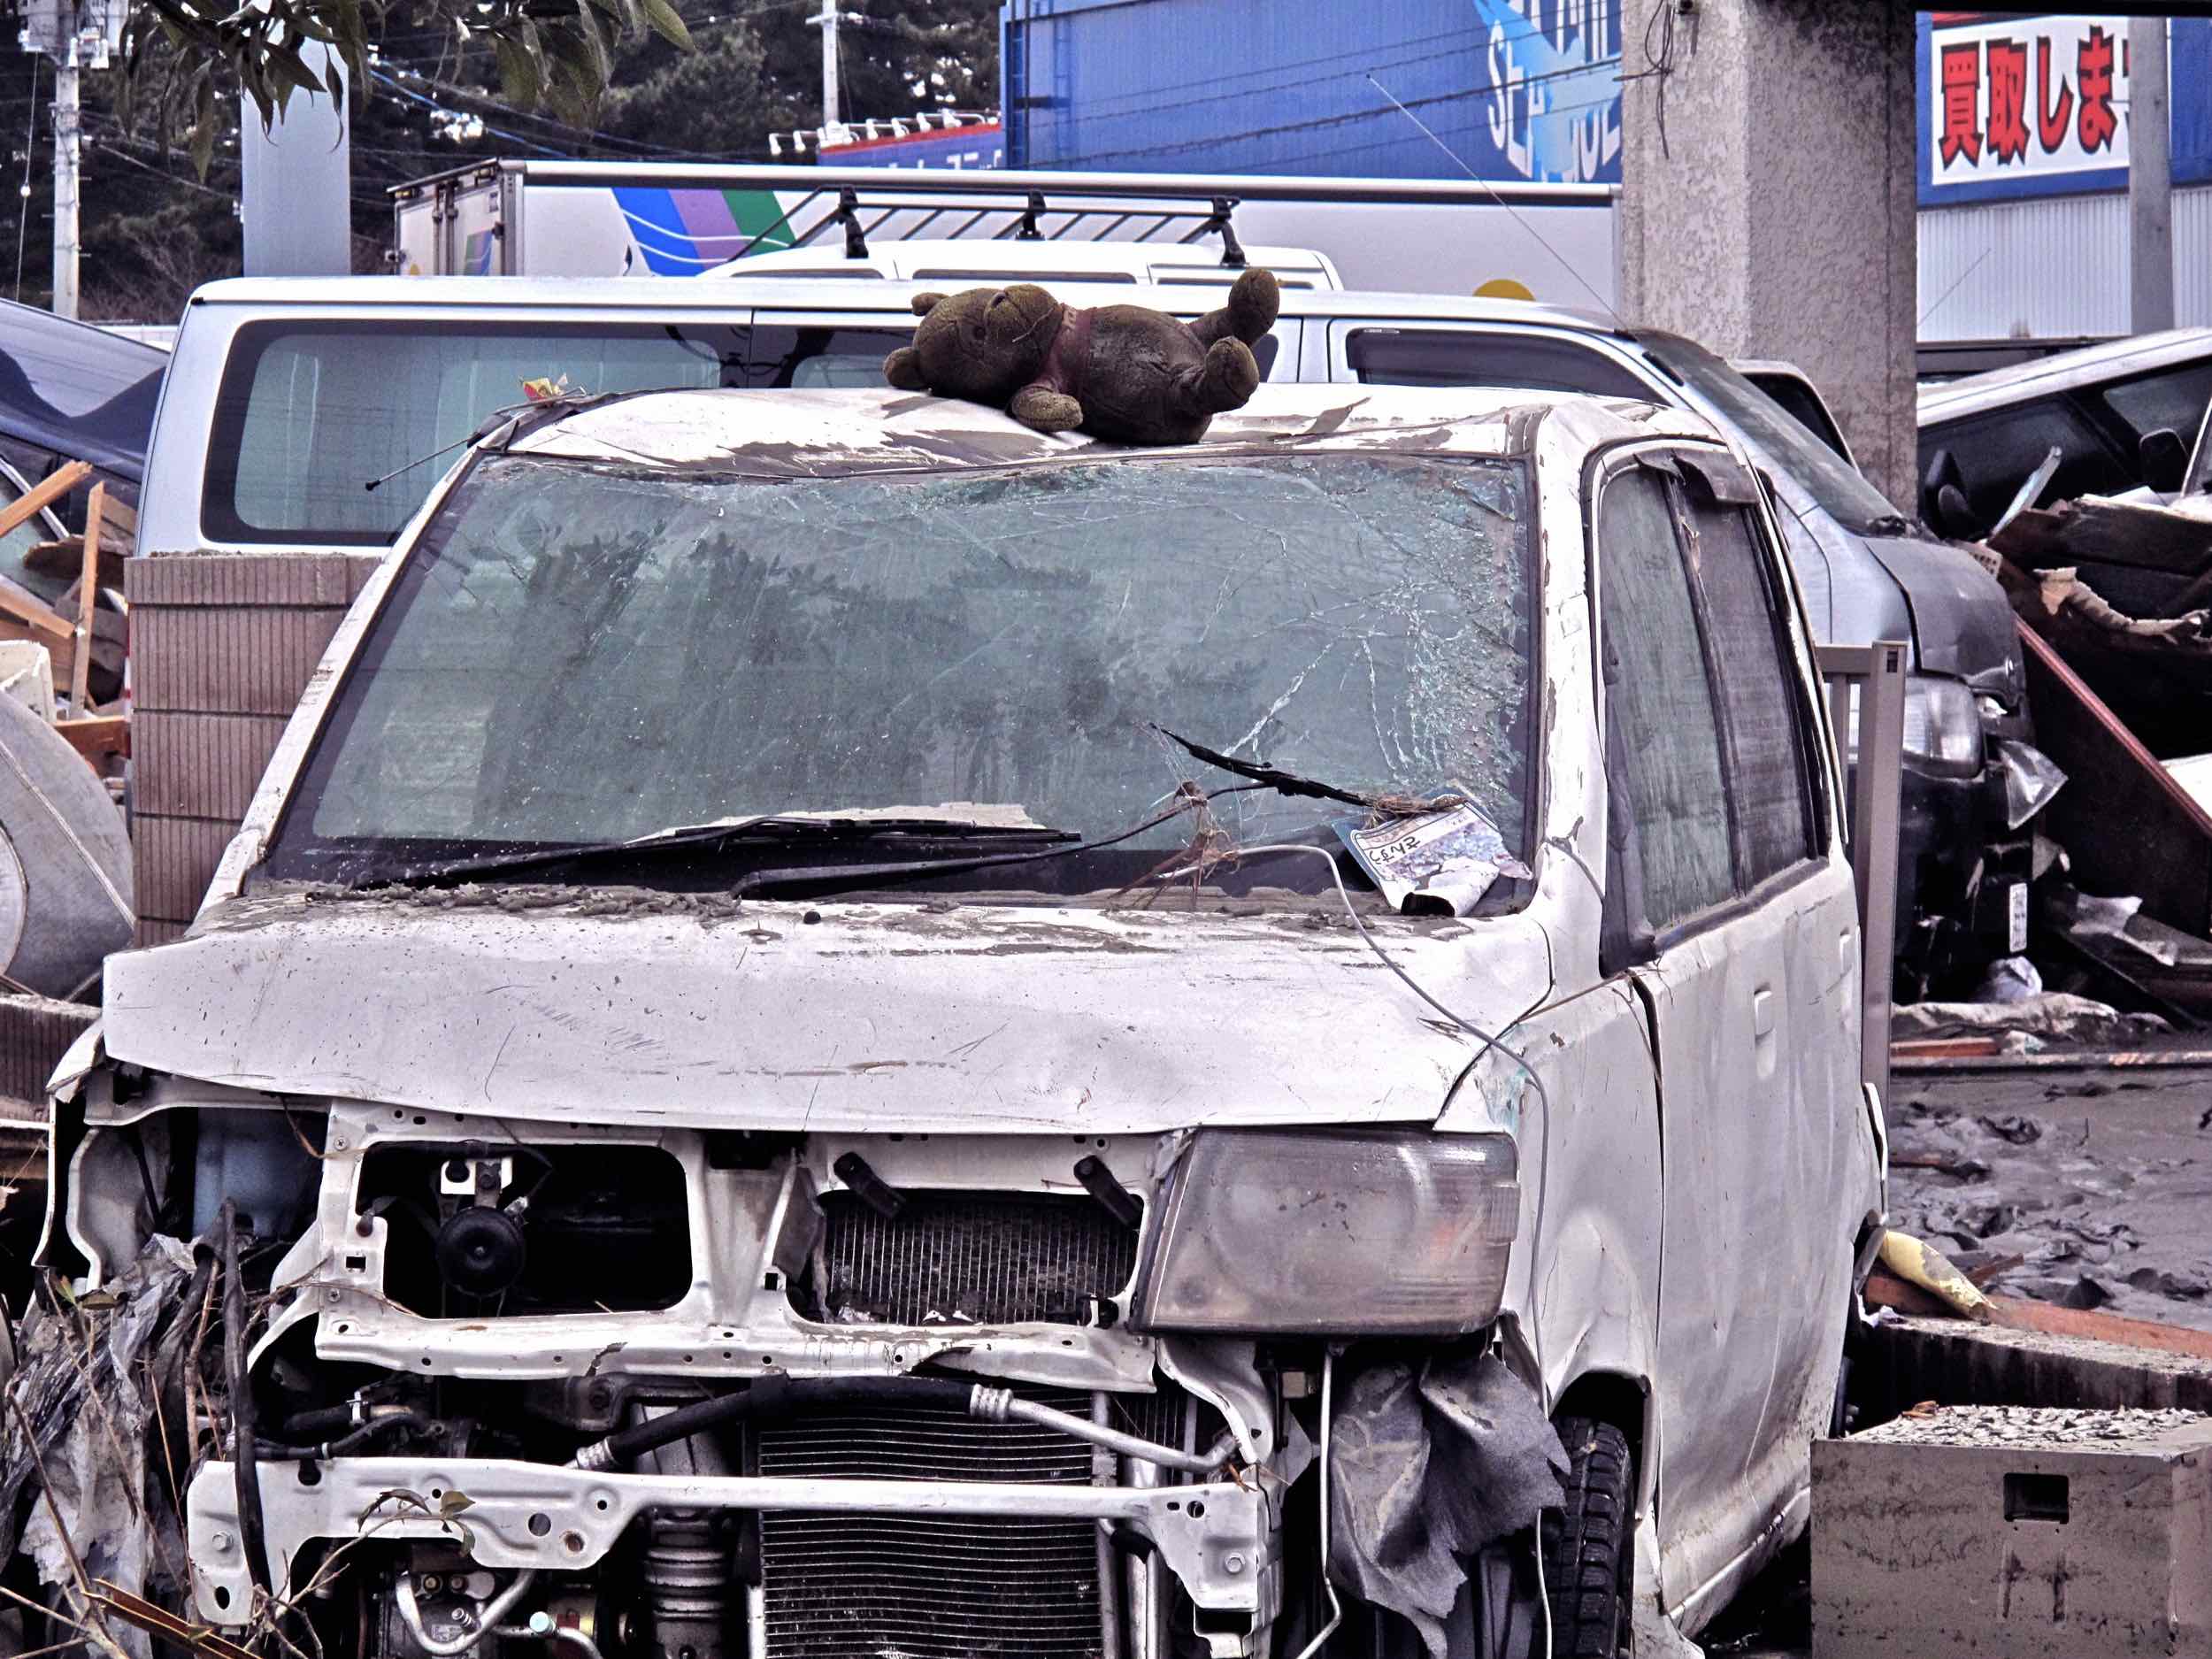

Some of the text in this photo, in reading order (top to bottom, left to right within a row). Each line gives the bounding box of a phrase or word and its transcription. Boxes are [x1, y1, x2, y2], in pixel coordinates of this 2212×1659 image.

[1939, 25, 2130, 171] 買取しま
[1369, 836, 1421, 865] さんすう
